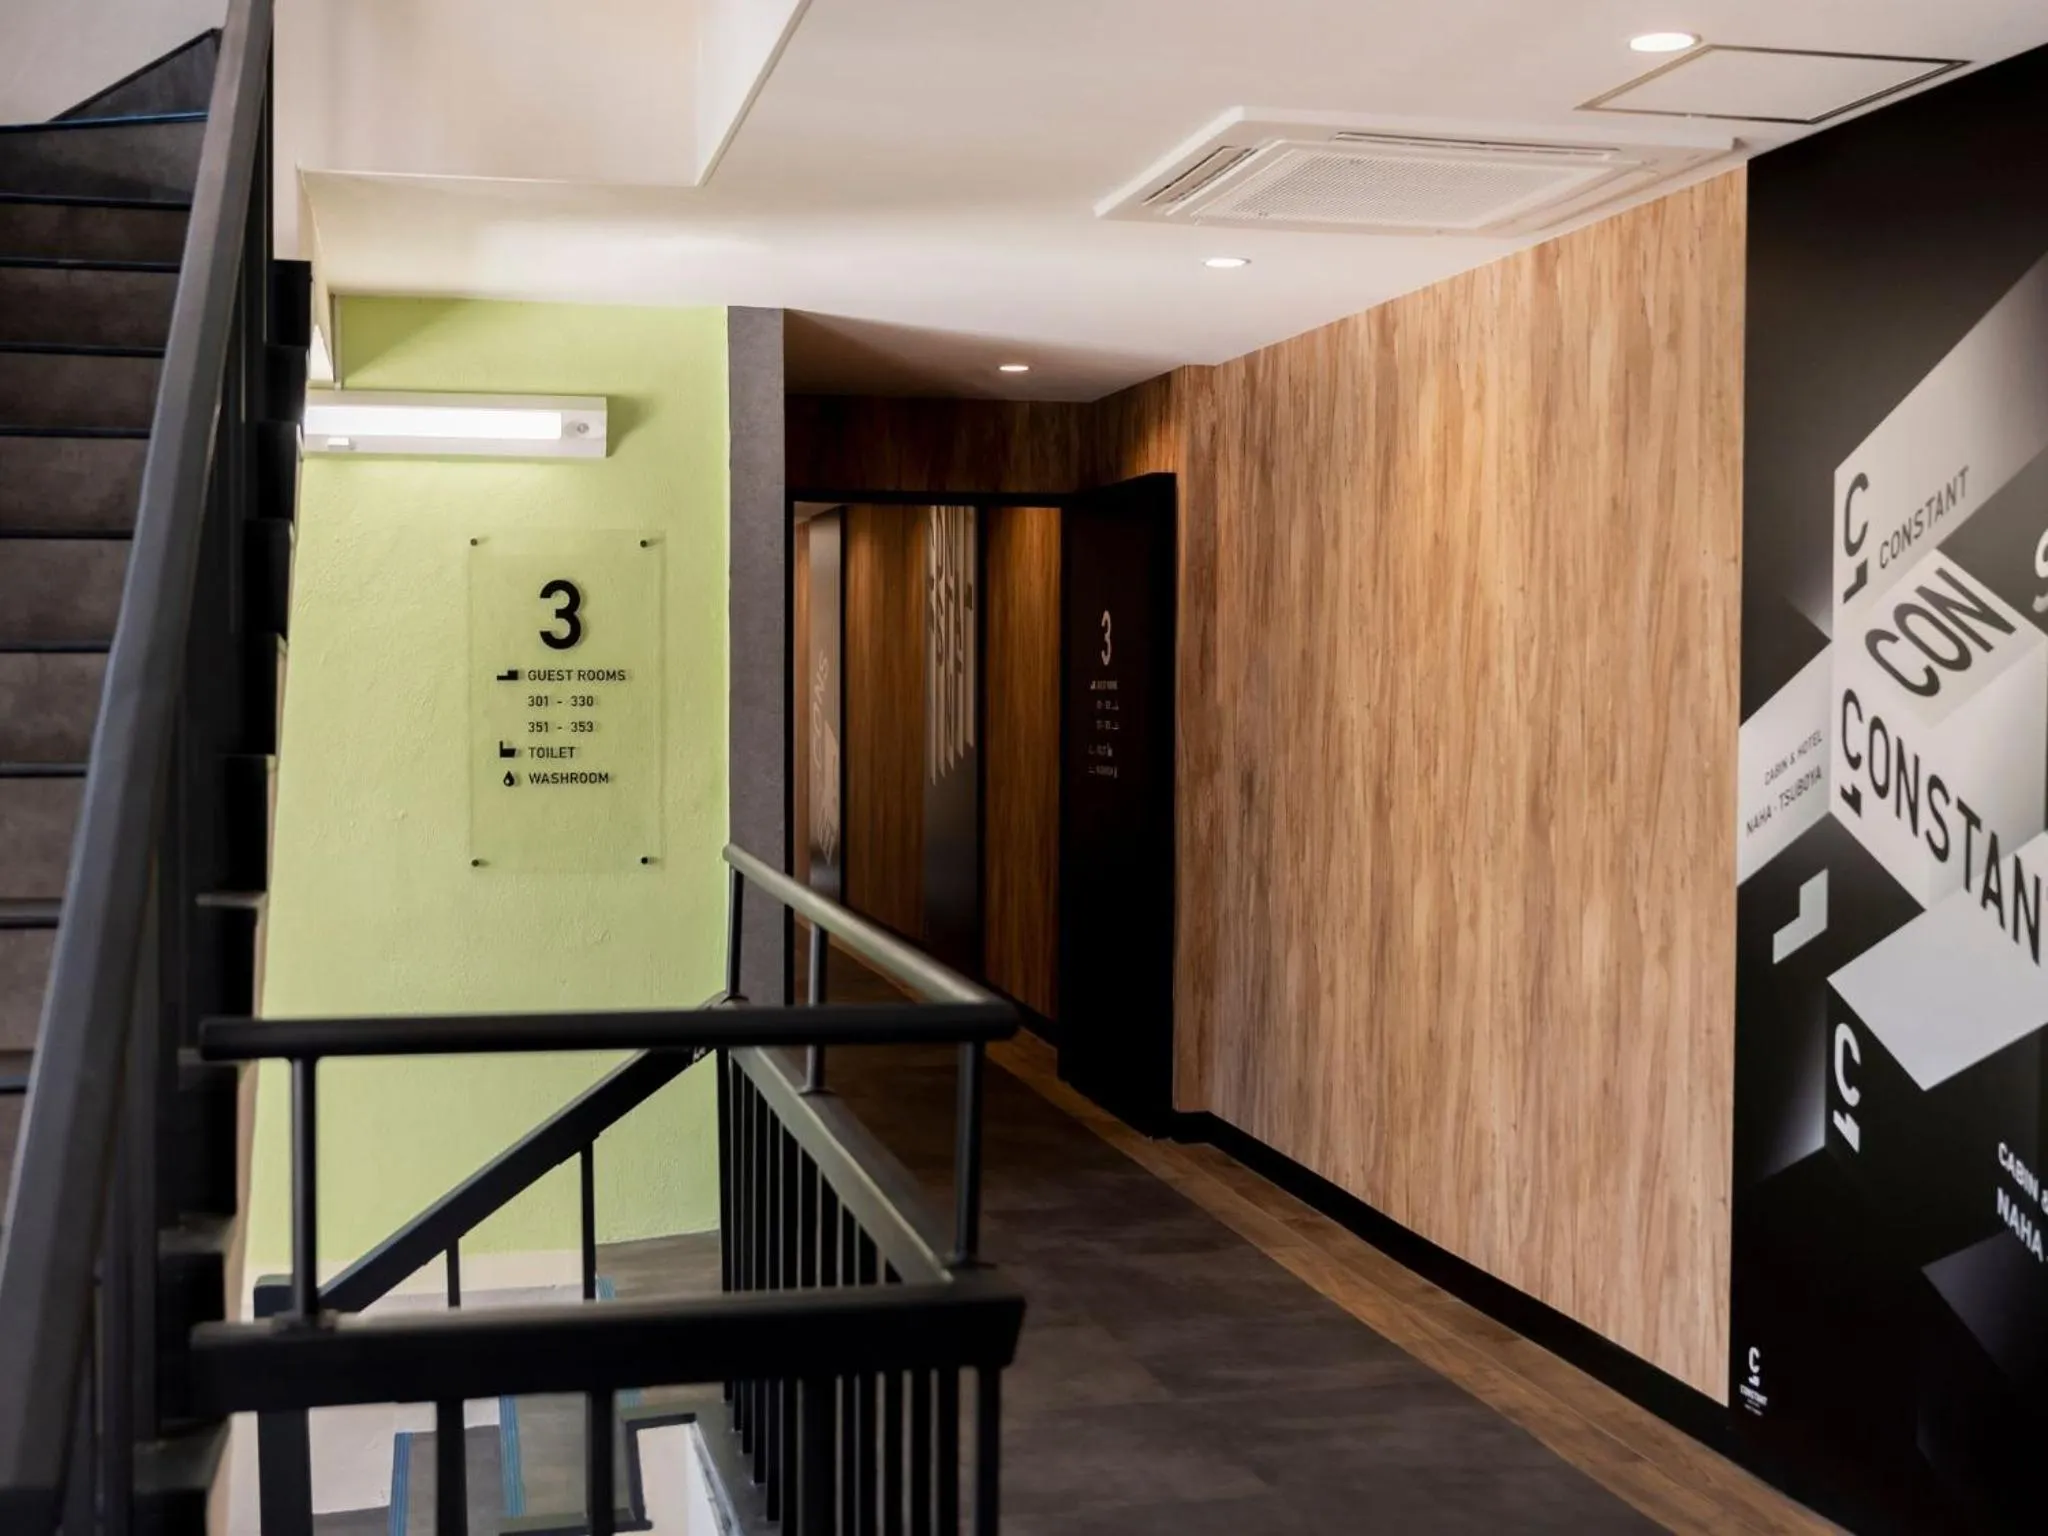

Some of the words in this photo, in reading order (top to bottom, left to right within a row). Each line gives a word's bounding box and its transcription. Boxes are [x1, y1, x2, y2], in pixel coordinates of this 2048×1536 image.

[1879, 464, 1969, 570] CONSTANT
[539, 579, 581, 650] 3
[1101, 609, 1112, 667] 3
[1865, 567, 2017, 697] CON
[527, 669, 574, 682] GUEST
[577, 669, 627, 682] ROOMS
[527, 695, 549, 707] 301
[570, 695, 594, 707] 330
[527, 721, 549, 733] 351
[570, 721, 594, 733] 353
[528, 746, 576, 759] TOILET
[528, 772, 609, 785] WASHROOM
[1764, 758, 1789, 787] CABIN
[1797, 730, 1823, 759] HOTEL
[1746, 803, 1772, 838] NAHA
[1778, 764, 1822, 812] TSUBOYA
[1841, 689, 2048, 966] CONSTAN
[1998, 1141, 2039, 1202] CABIN
[1997, 1186, 2044, 1263] NAHA
